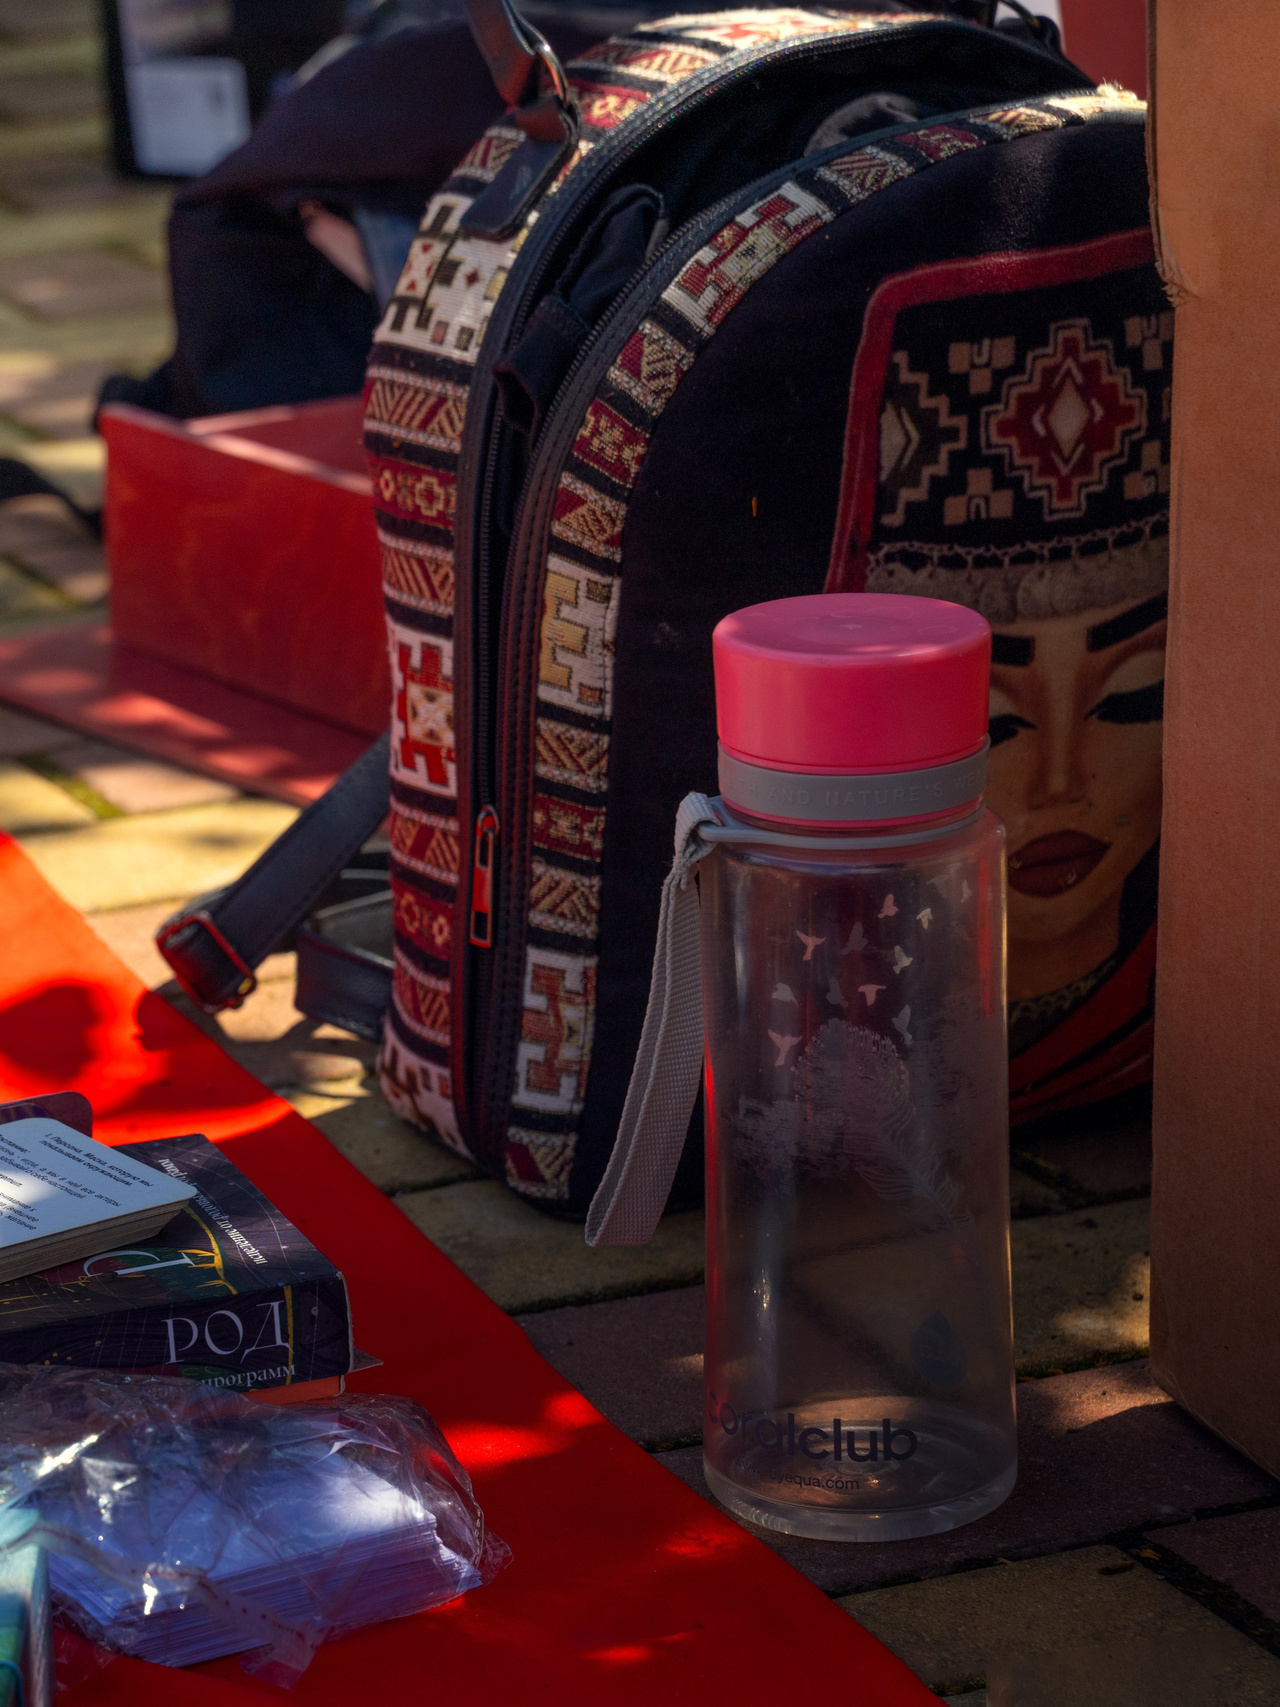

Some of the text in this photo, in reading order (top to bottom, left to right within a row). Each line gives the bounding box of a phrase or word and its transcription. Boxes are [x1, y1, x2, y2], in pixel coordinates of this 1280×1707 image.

[39, 1140, 85, 1163] показываем
[29, 1172, 49, 1182] себе
[107, 1165, 141, 1181] которую
[138, 1179, 154, 1188] мы
[65, 1180, 83, 1188] ней
[79, 1187, 96, 1195] все
[4, 1214, 37, 1231] желание
[216, 1219, 233, 1229] от
[225, 1228, 268, 1265] исцеление
[160, 1300, 295, 1365] РОД
